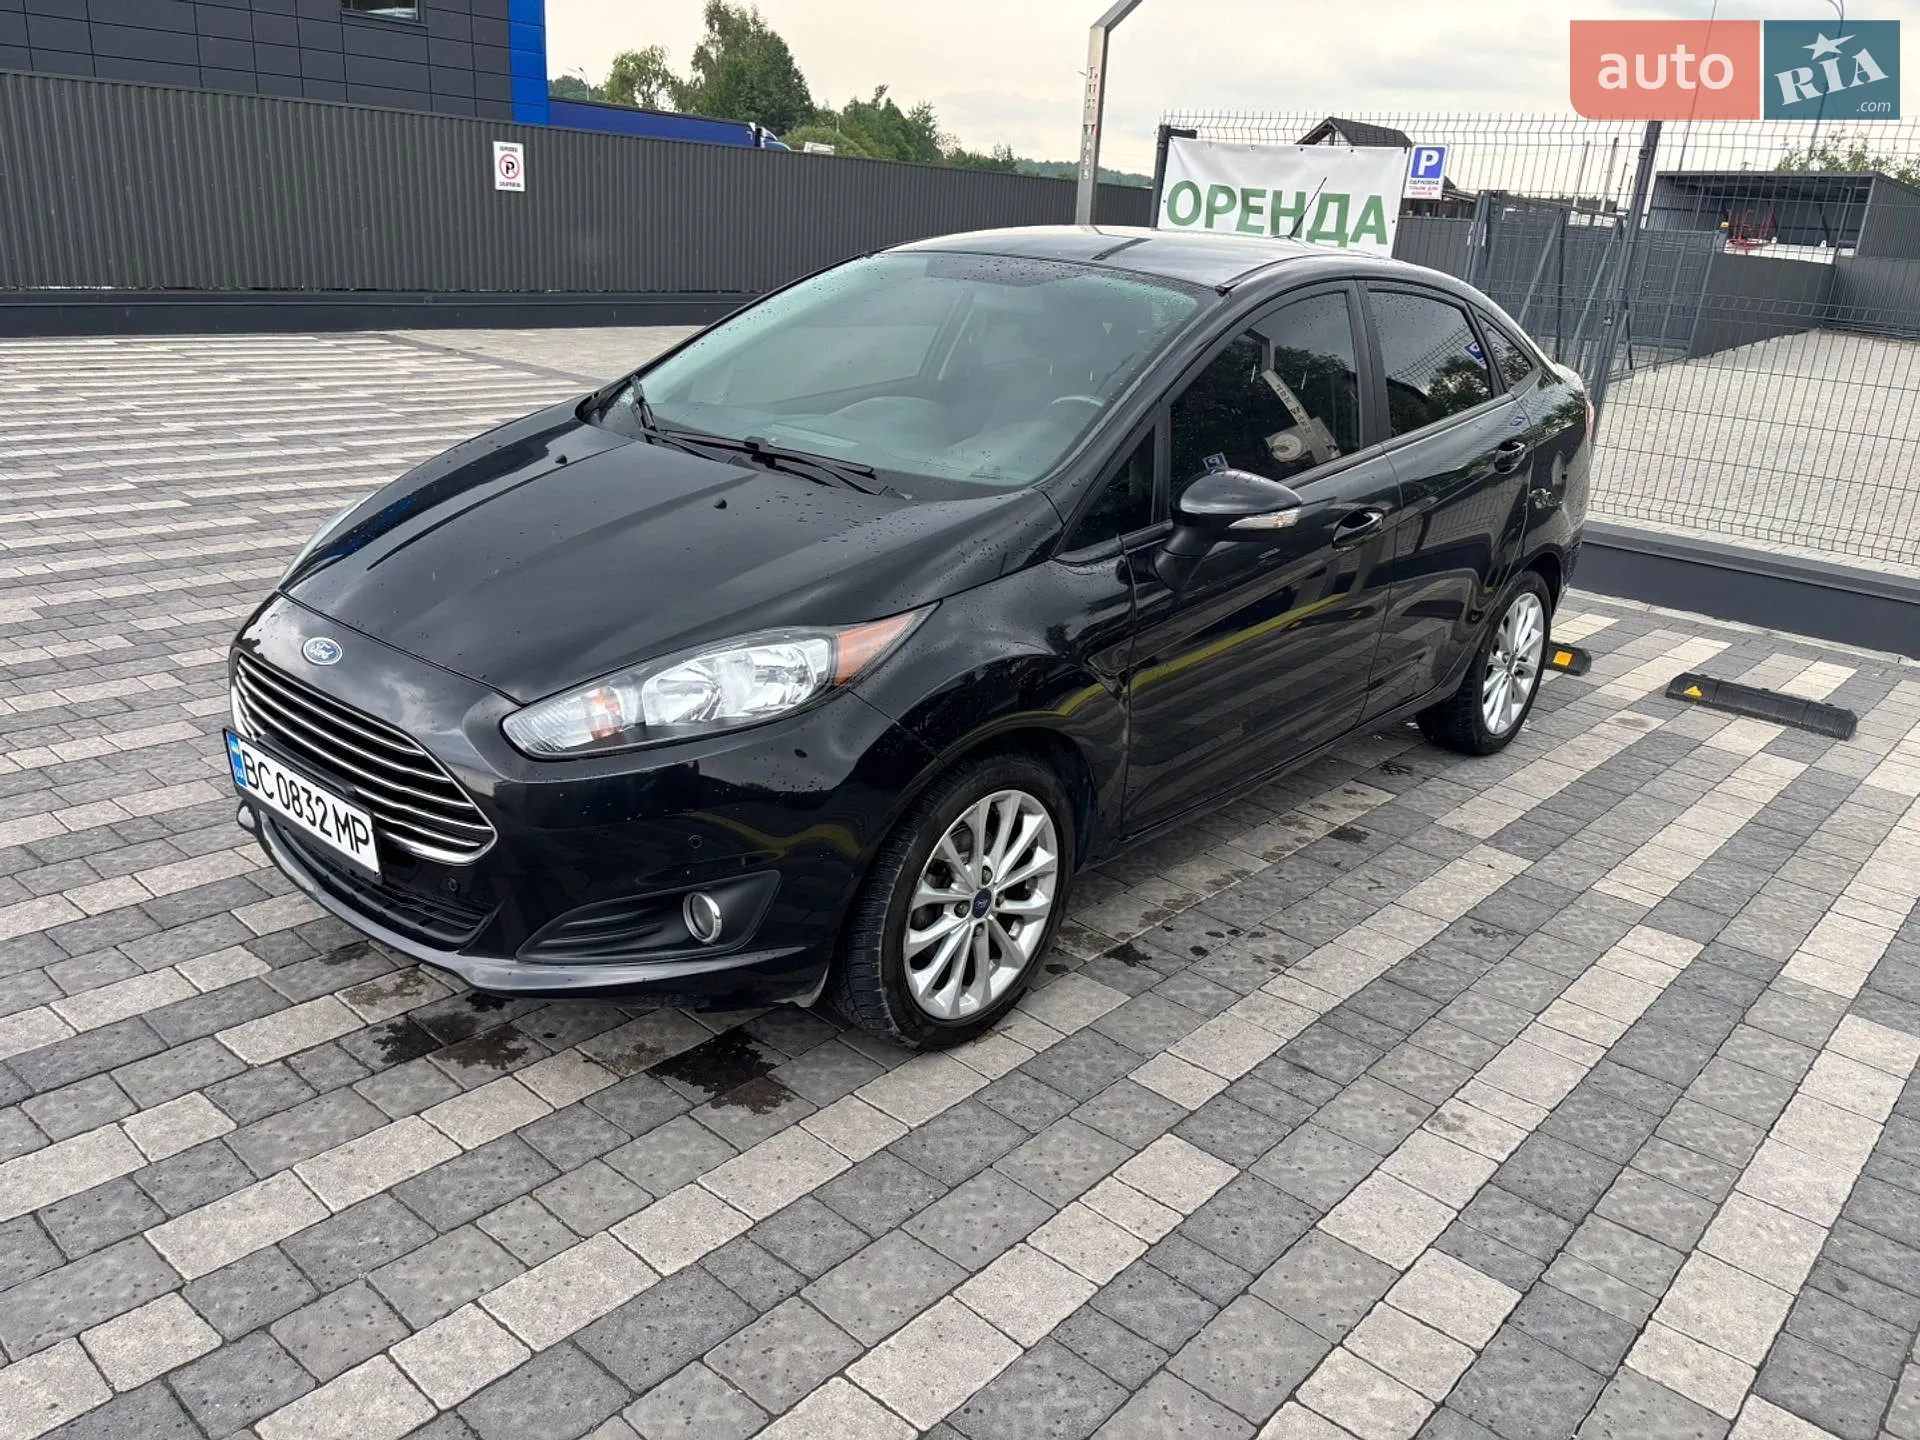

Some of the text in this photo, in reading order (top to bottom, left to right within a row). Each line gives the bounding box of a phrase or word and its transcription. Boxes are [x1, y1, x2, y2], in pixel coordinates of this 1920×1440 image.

[1418, 150, 1440, 176] P
[1167, 180, 1388, 248] ОРЕНДА
[242, 748, 370, 855] BC 0832 MP
